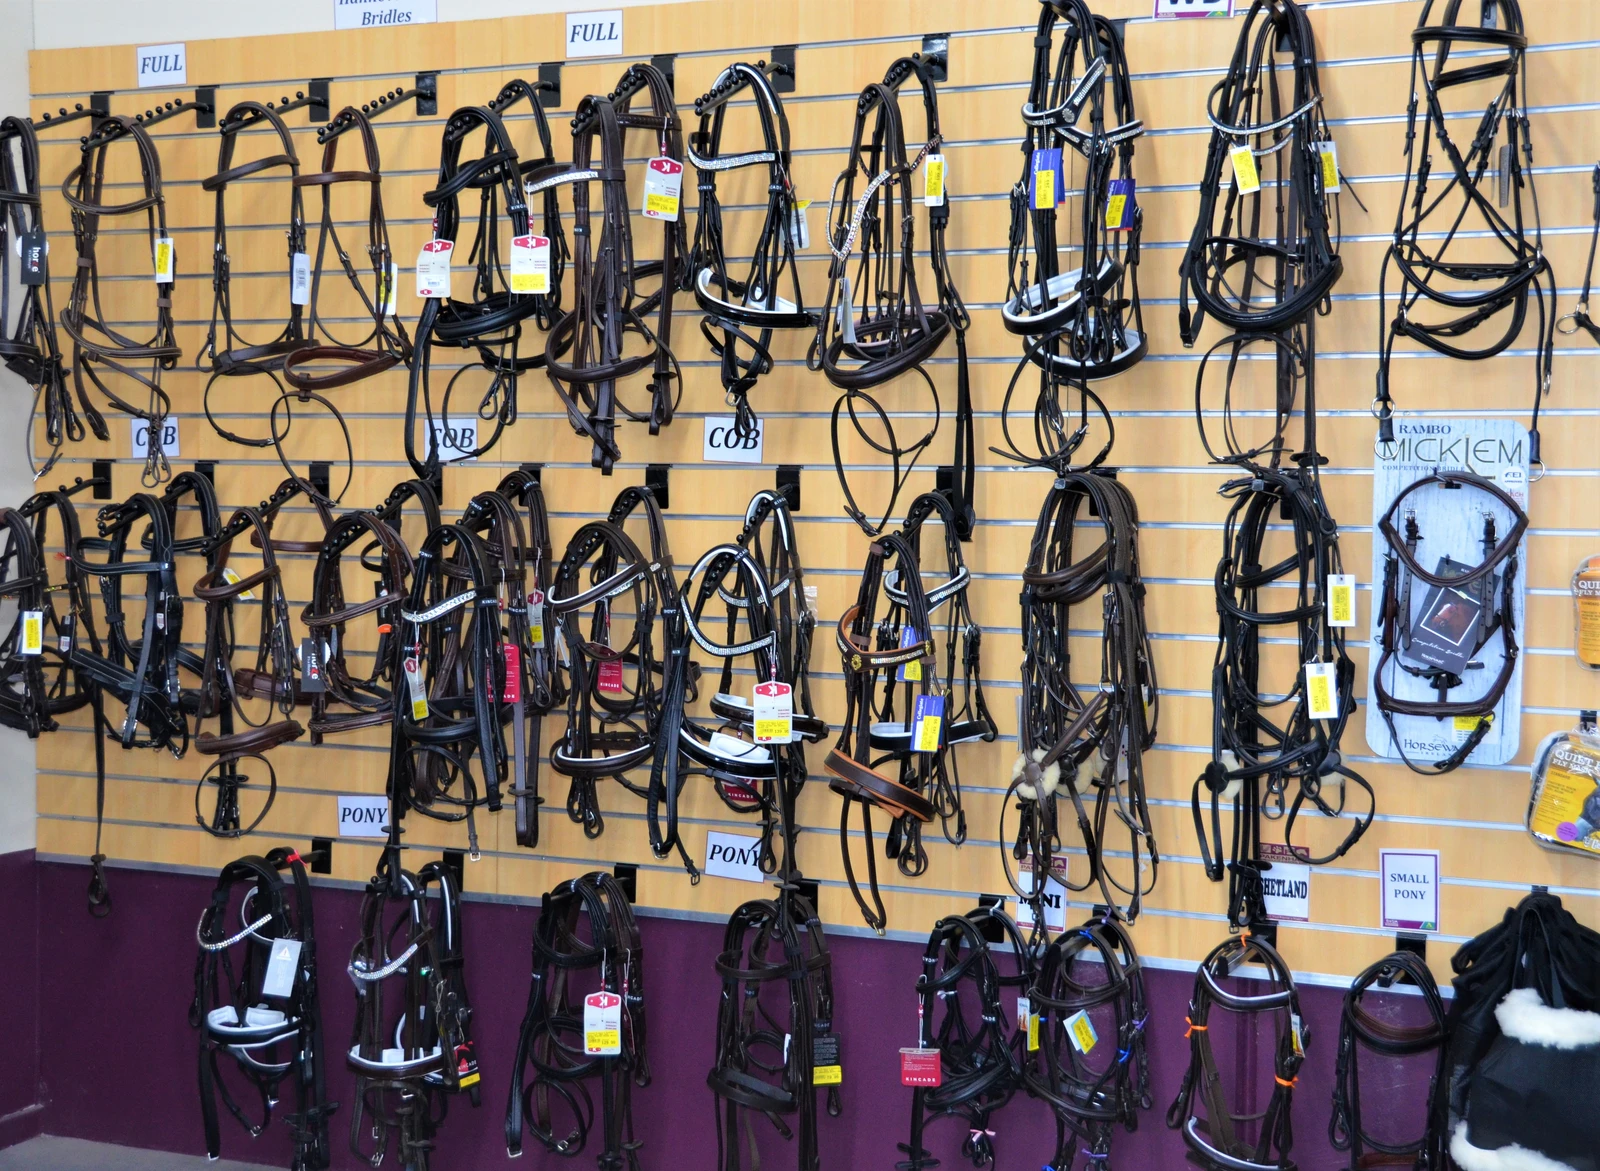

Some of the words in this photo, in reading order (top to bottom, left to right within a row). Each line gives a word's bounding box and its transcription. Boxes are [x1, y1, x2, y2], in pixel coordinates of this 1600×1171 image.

[361, 9, 412, 26] Bridles
[570, 22, 619, 43] FULL
[141, 54, 183, 75] FULL
[32, 247, 41, 273] horze
[136, 426, 176, 448] CB
[709, 426, 761, 450] COB
[1399, 424, 1452, 435] RAMBO
[916, 698, 924, 720] Collegiate
[1552, 758, 1568, 767] FLY
[1555, 749, 1593, 768] QUIET
[341, 806, 388, 824] PONY
[709, 844, 762, 868] PONY
[1260, 854, 1299, 864] PAKENH
[1390, 873, 1430, 885] SMALL
[1018, 892, 1062, 909] MNI
[1394, 888, 1427, 901] PONY
